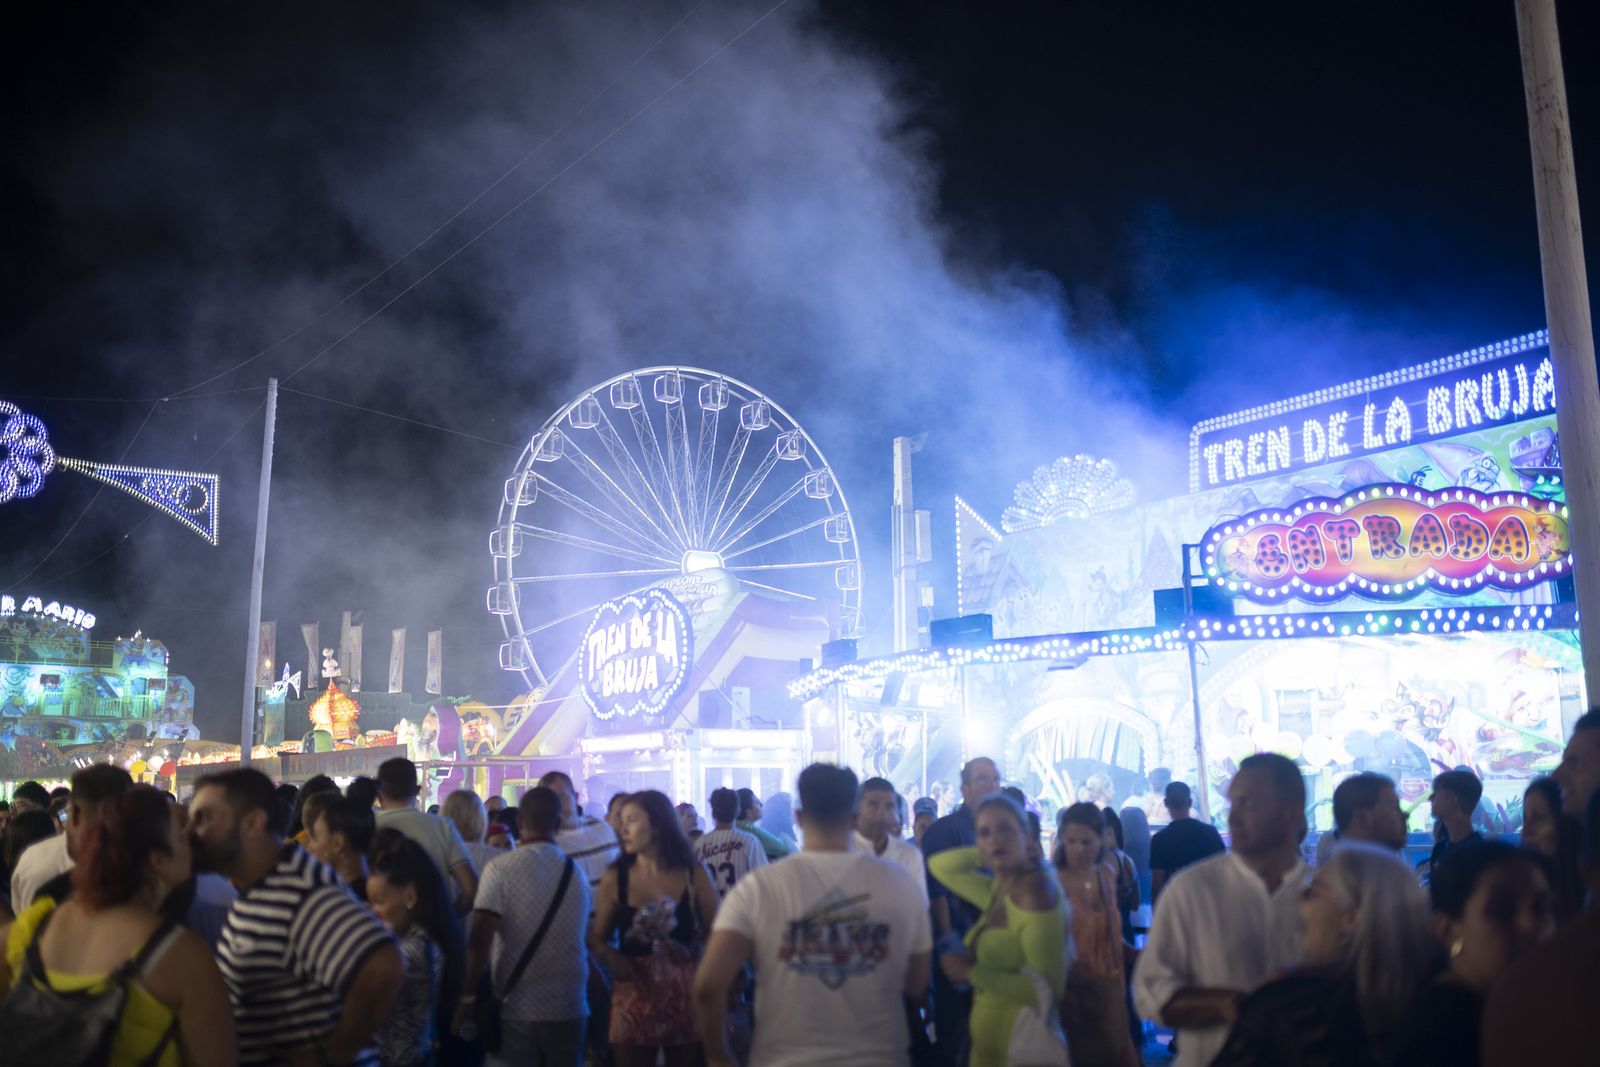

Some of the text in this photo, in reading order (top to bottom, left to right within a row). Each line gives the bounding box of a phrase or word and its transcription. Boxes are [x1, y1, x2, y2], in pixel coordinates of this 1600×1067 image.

[1203, 357, 1556, 484] TREN DE LA BRUJA
[1256, 513, 1530, 577] ENTRADA
[21, 595, 96, 629] MARIO
[588, 609, 678, 681] TREN DE LA
[602, 655, 658, 697] BRUJA
